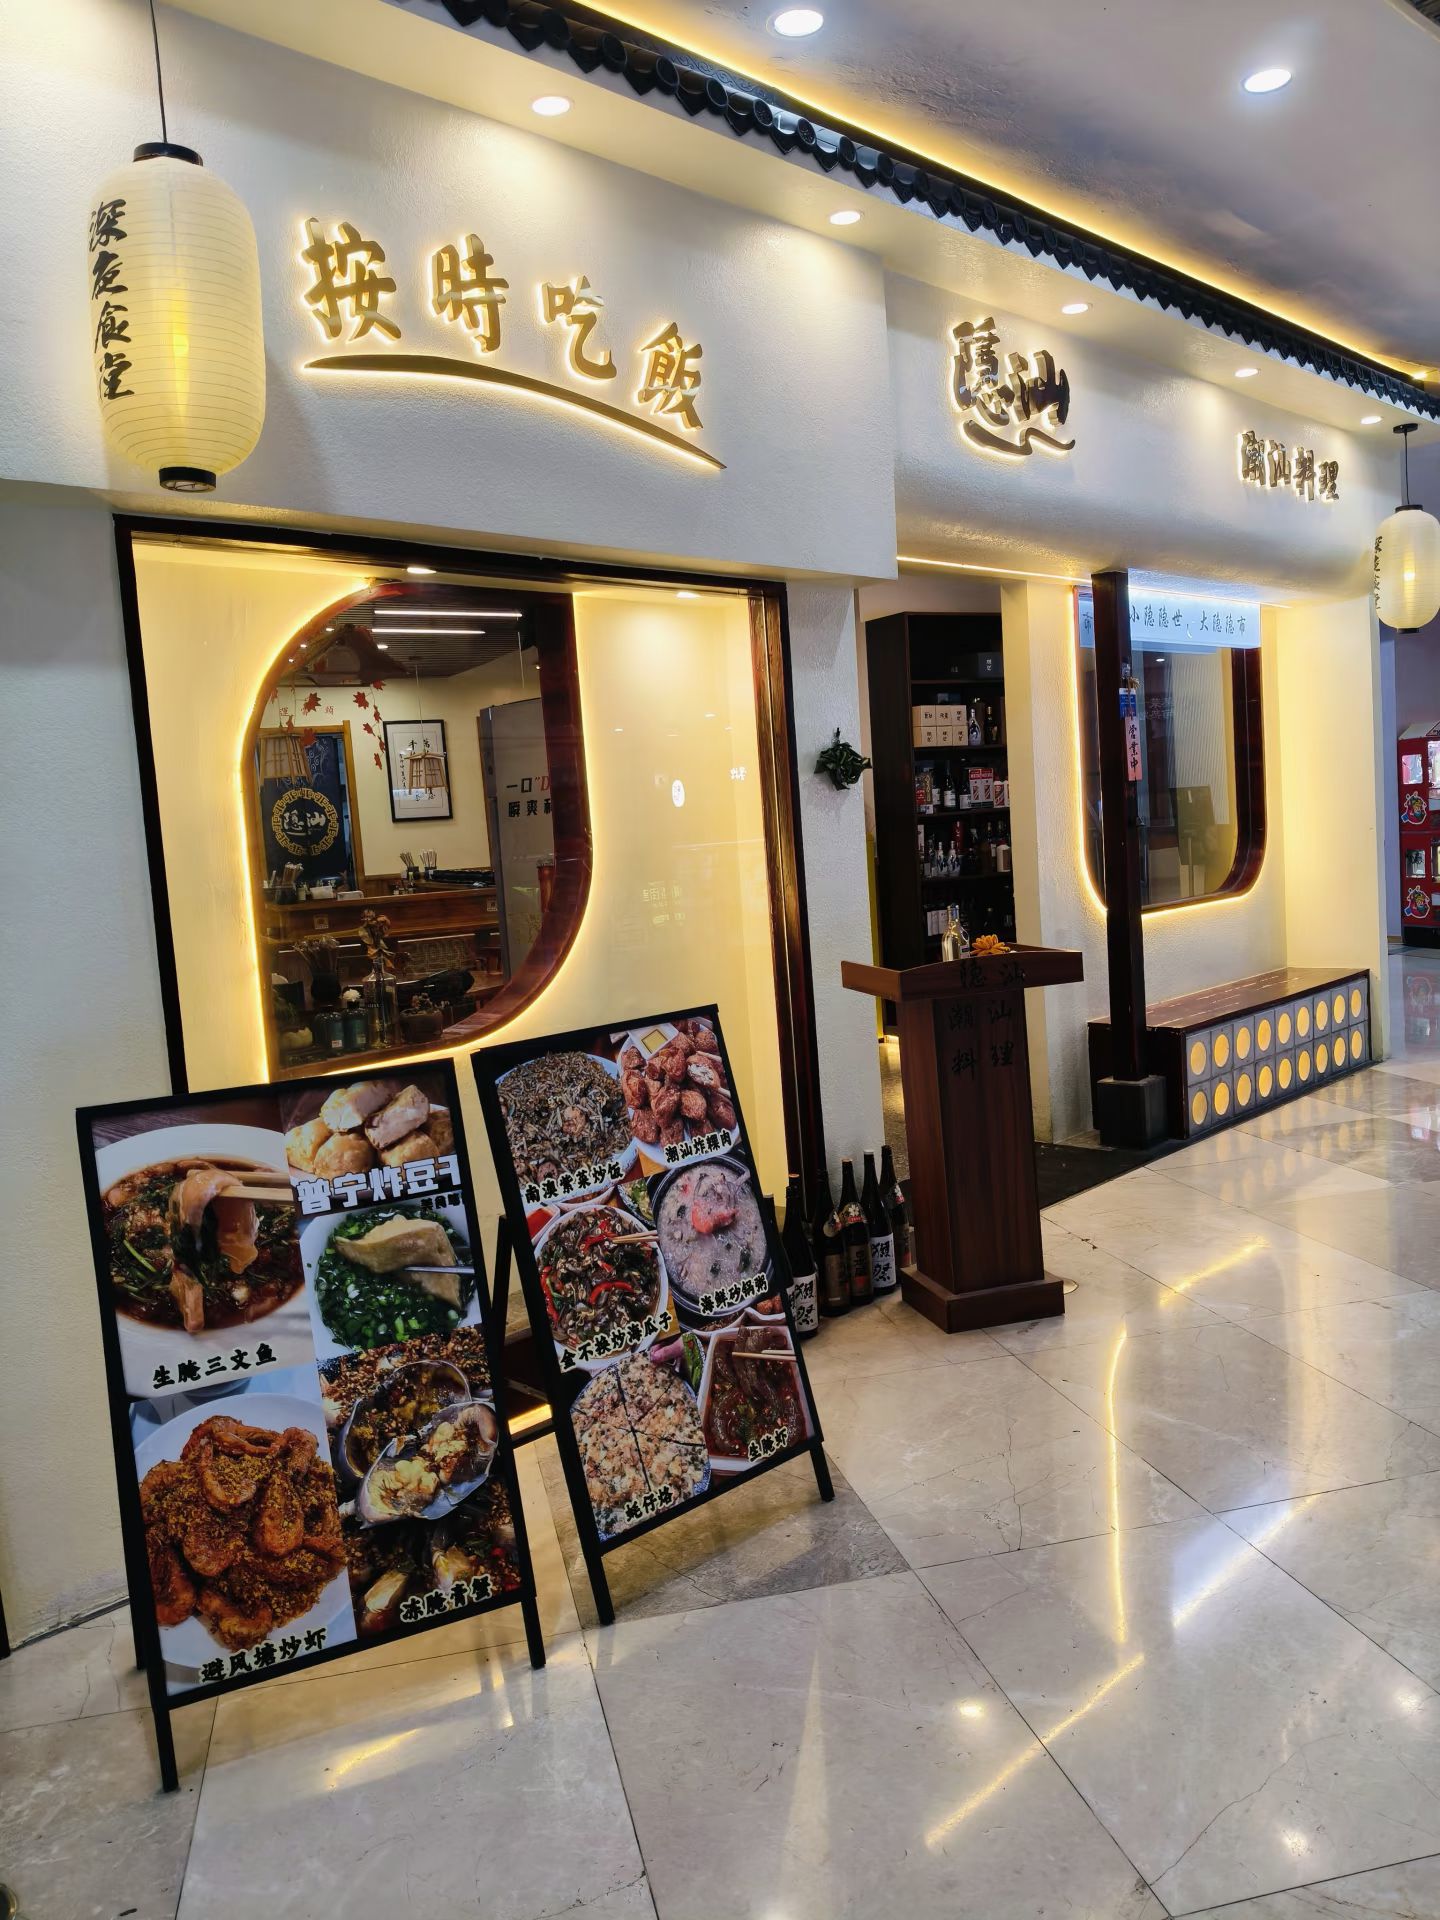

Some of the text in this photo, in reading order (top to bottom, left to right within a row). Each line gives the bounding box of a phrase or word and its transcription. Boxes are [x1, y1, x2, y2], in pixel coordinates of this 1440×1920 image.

[88, 199, 135, 400] 深夜食堂
[302, 217, 703, 429] 按時吃飯
[525, 1162, 624, 1203] 南澳紫菜炒饭
[700, 1275, 767, 1314] 海鲜砂锅粥
[560, 1311, 671, 1370] 金不换炒海瓜子
[152, 1342, 277, 1390] 生腌三文鱼
[749, 1428, 787, 1462] 生腌虾
[625, 1486, 673, 1522] 蚝仔烙
[201, 1627, 327, 1683] 避风塘炒虾
